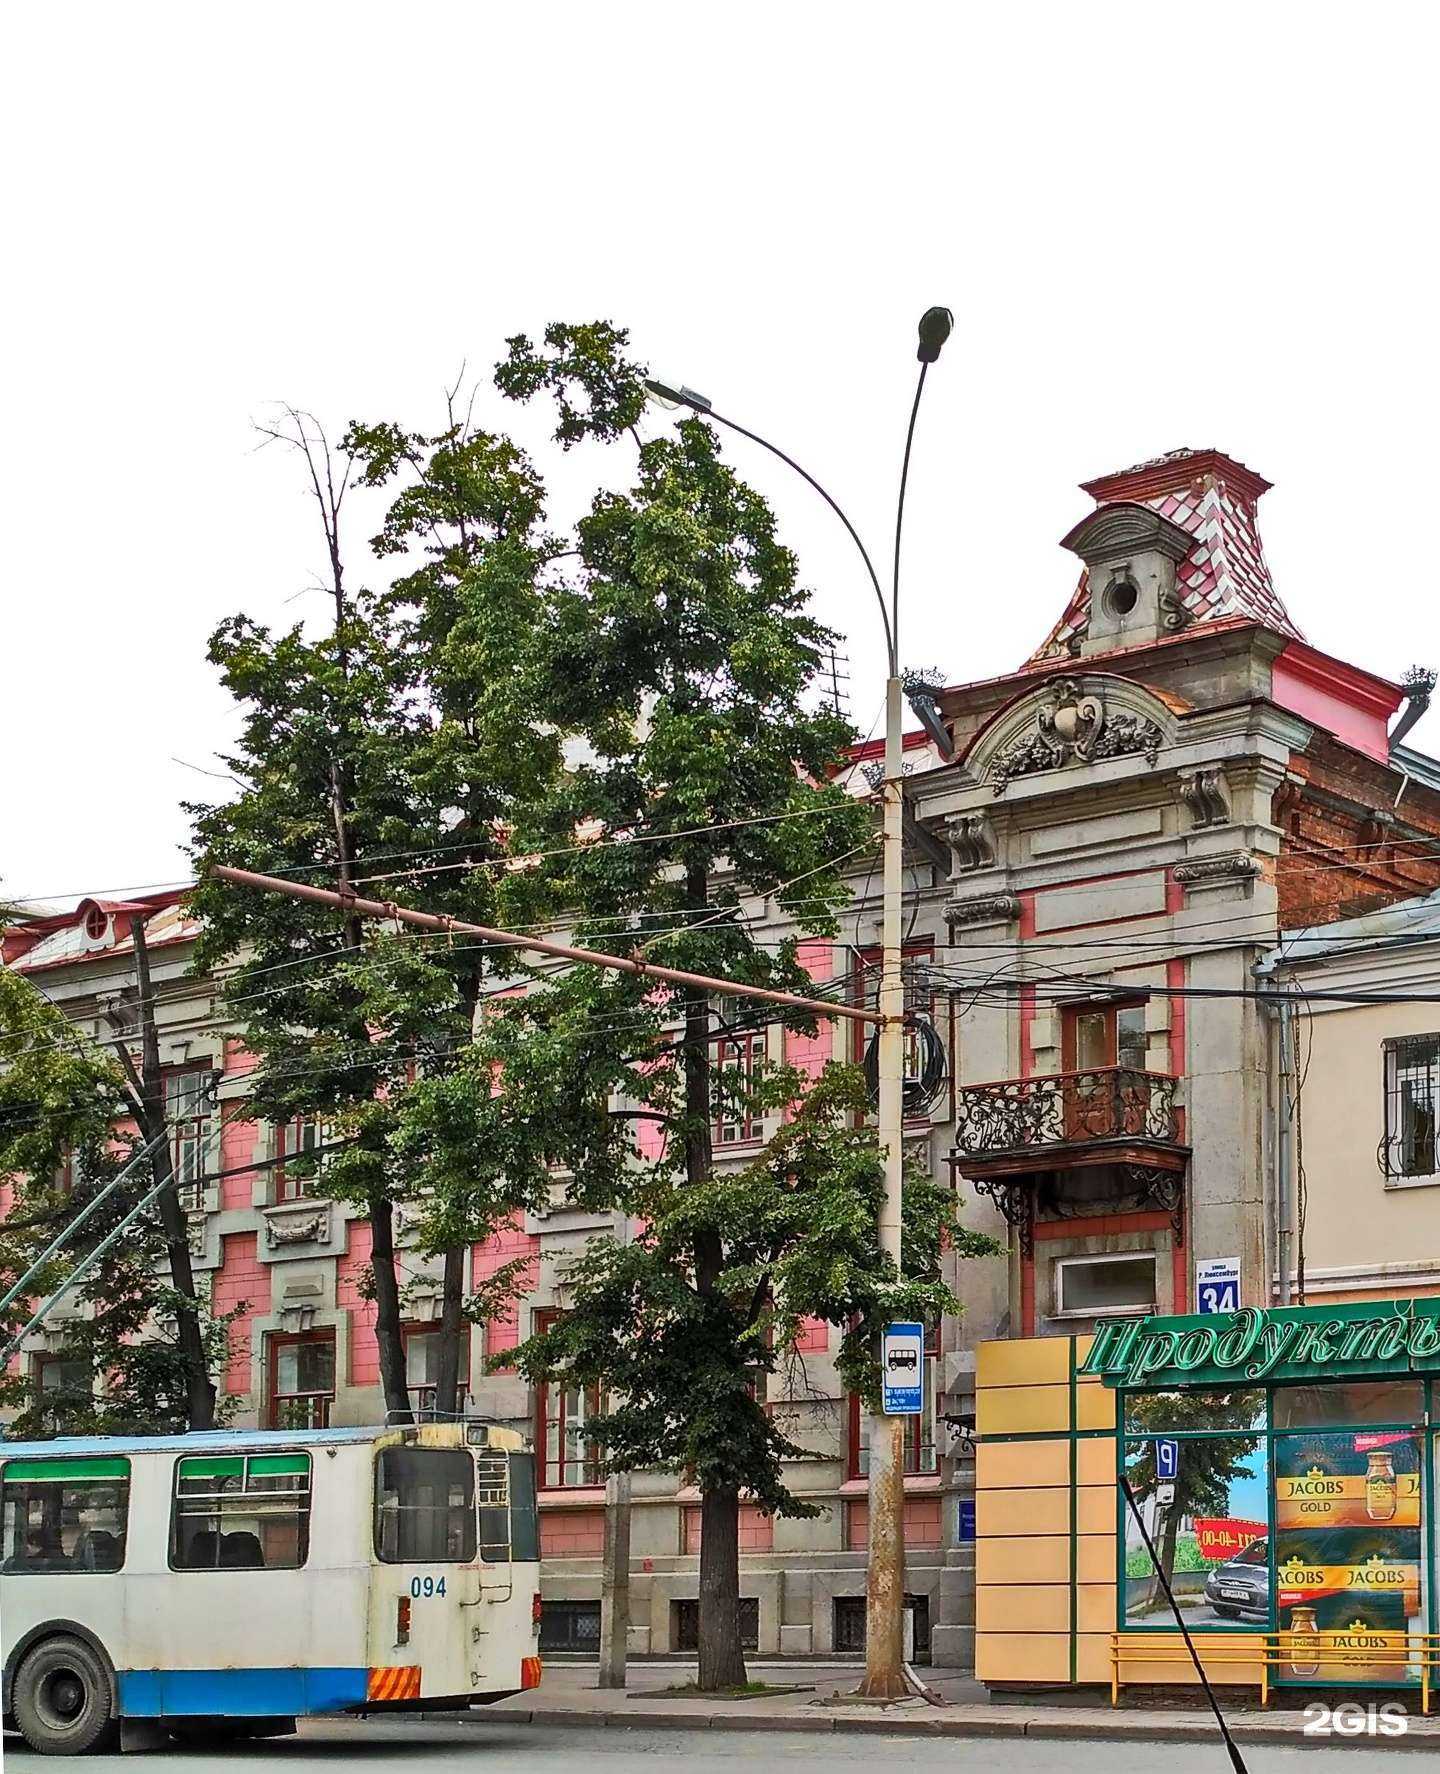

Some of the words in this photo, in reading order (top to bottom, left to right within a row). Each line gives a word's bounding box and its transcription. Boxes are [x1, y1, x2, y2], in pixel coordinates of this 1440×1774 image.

[1203, 1286, 1236, 1313] 34
[1288, 1481, 1344, 1497] JACOBS
[1300, 1503, 1331, 1512] GOLD
[1347, 1570, 1405, 1585] JACOBS
[411, 1576, 446, 1598] 094
[1333, 1637, 1387, 1648] JACOBS
